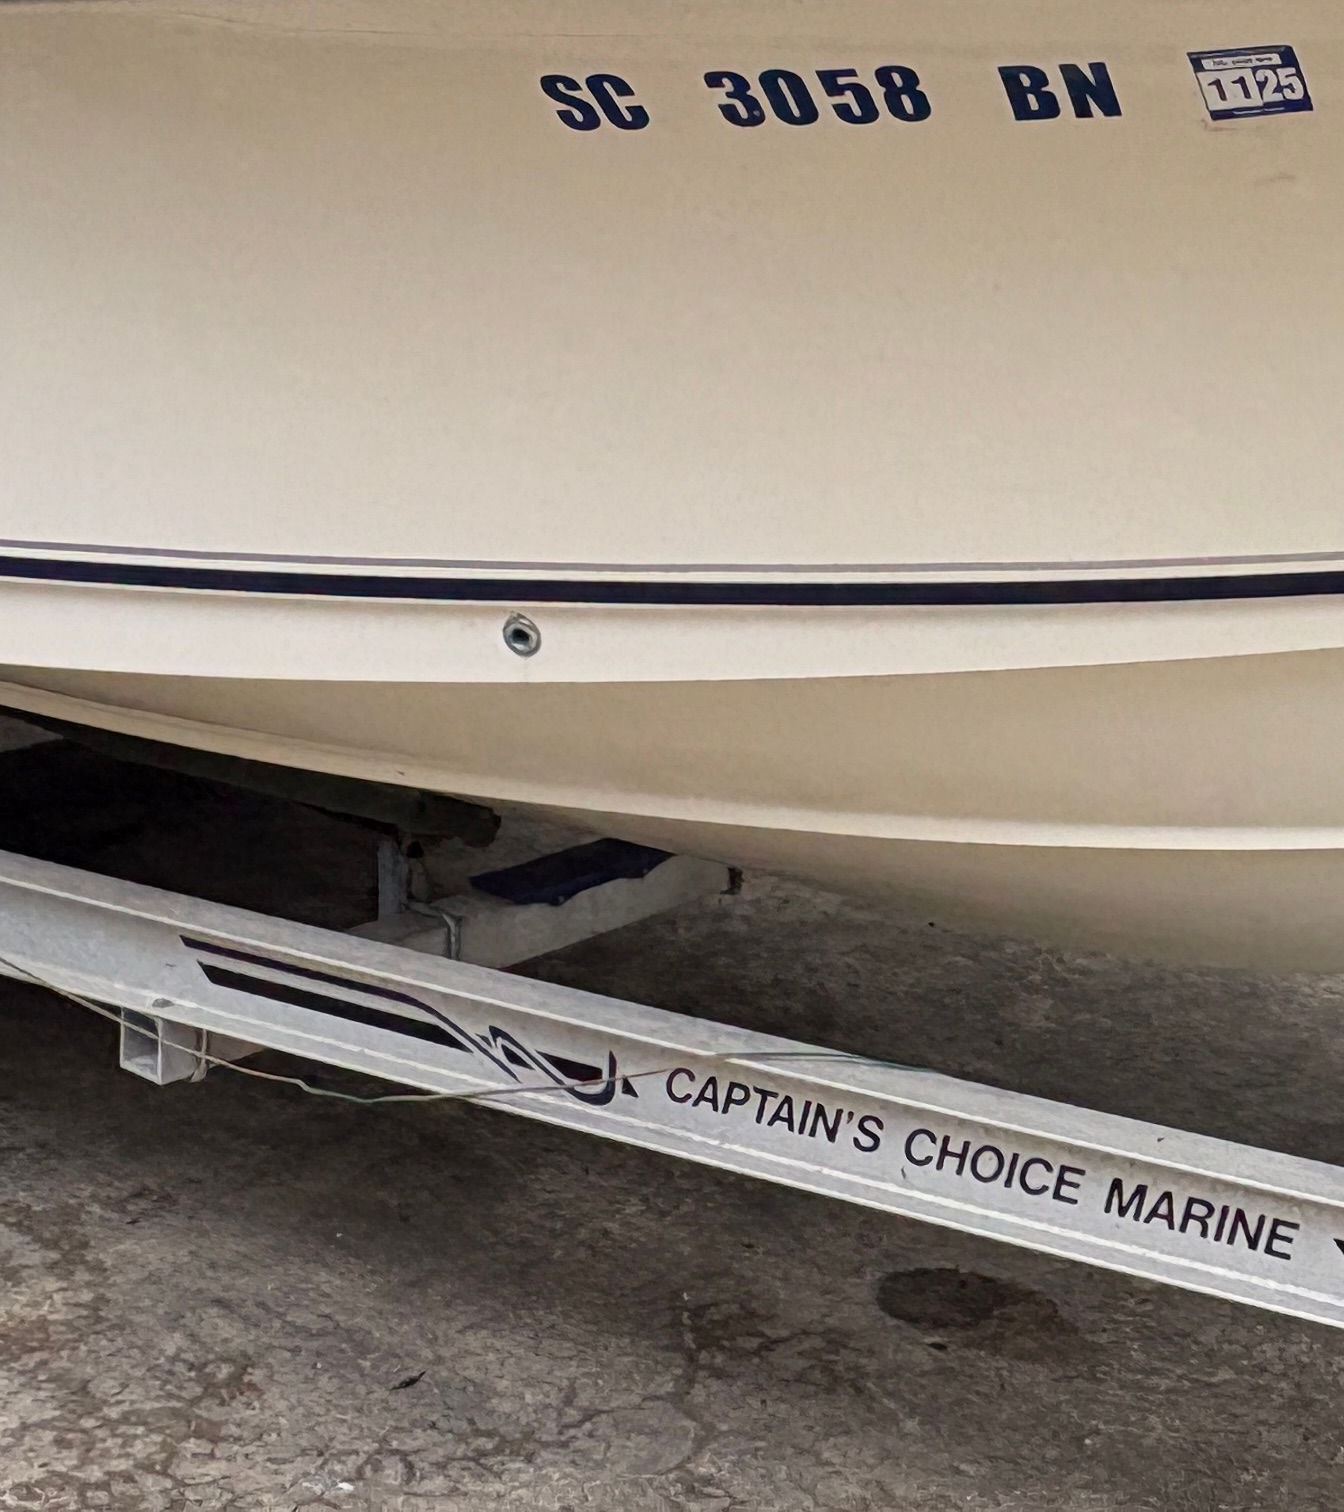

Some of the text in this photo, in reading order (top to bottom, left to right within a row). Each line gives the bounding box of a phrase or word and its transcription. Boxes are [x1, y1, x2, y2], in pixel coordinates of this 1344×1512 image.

[540, 62, 1123, 131] SC 3058 BN
[666, 1067, 1301, 1261] CAPTAIN'S CHOICE MARINE
